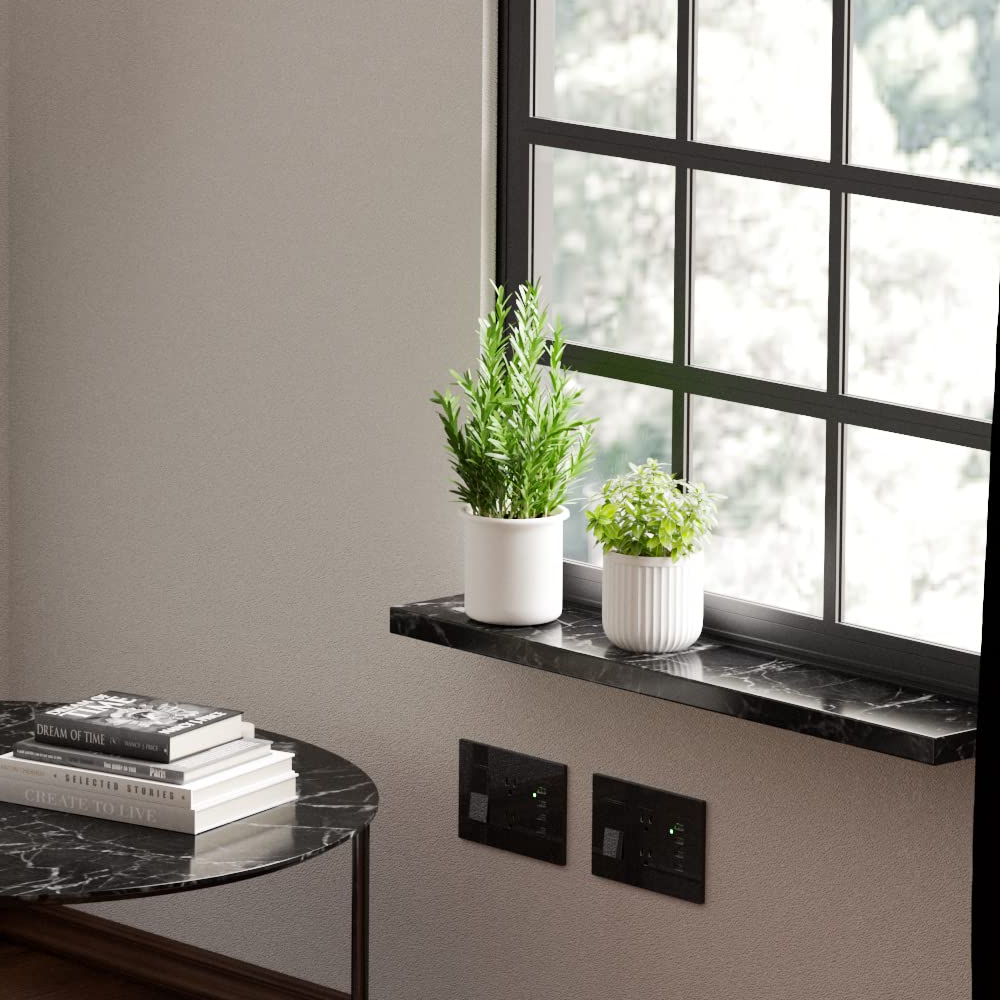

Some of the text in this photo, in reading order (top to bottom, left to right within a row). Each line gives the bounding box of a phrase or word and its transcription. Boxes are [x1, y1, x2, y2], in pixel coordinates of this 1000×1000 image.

[59, 695, 137, 719] TIME
[36, 723, 105, 745] DREAM OF TIME
[65, 773, 175, 801] SELECTED STORIES
[24, 788, 157, 824] CREATE TO LIVE
